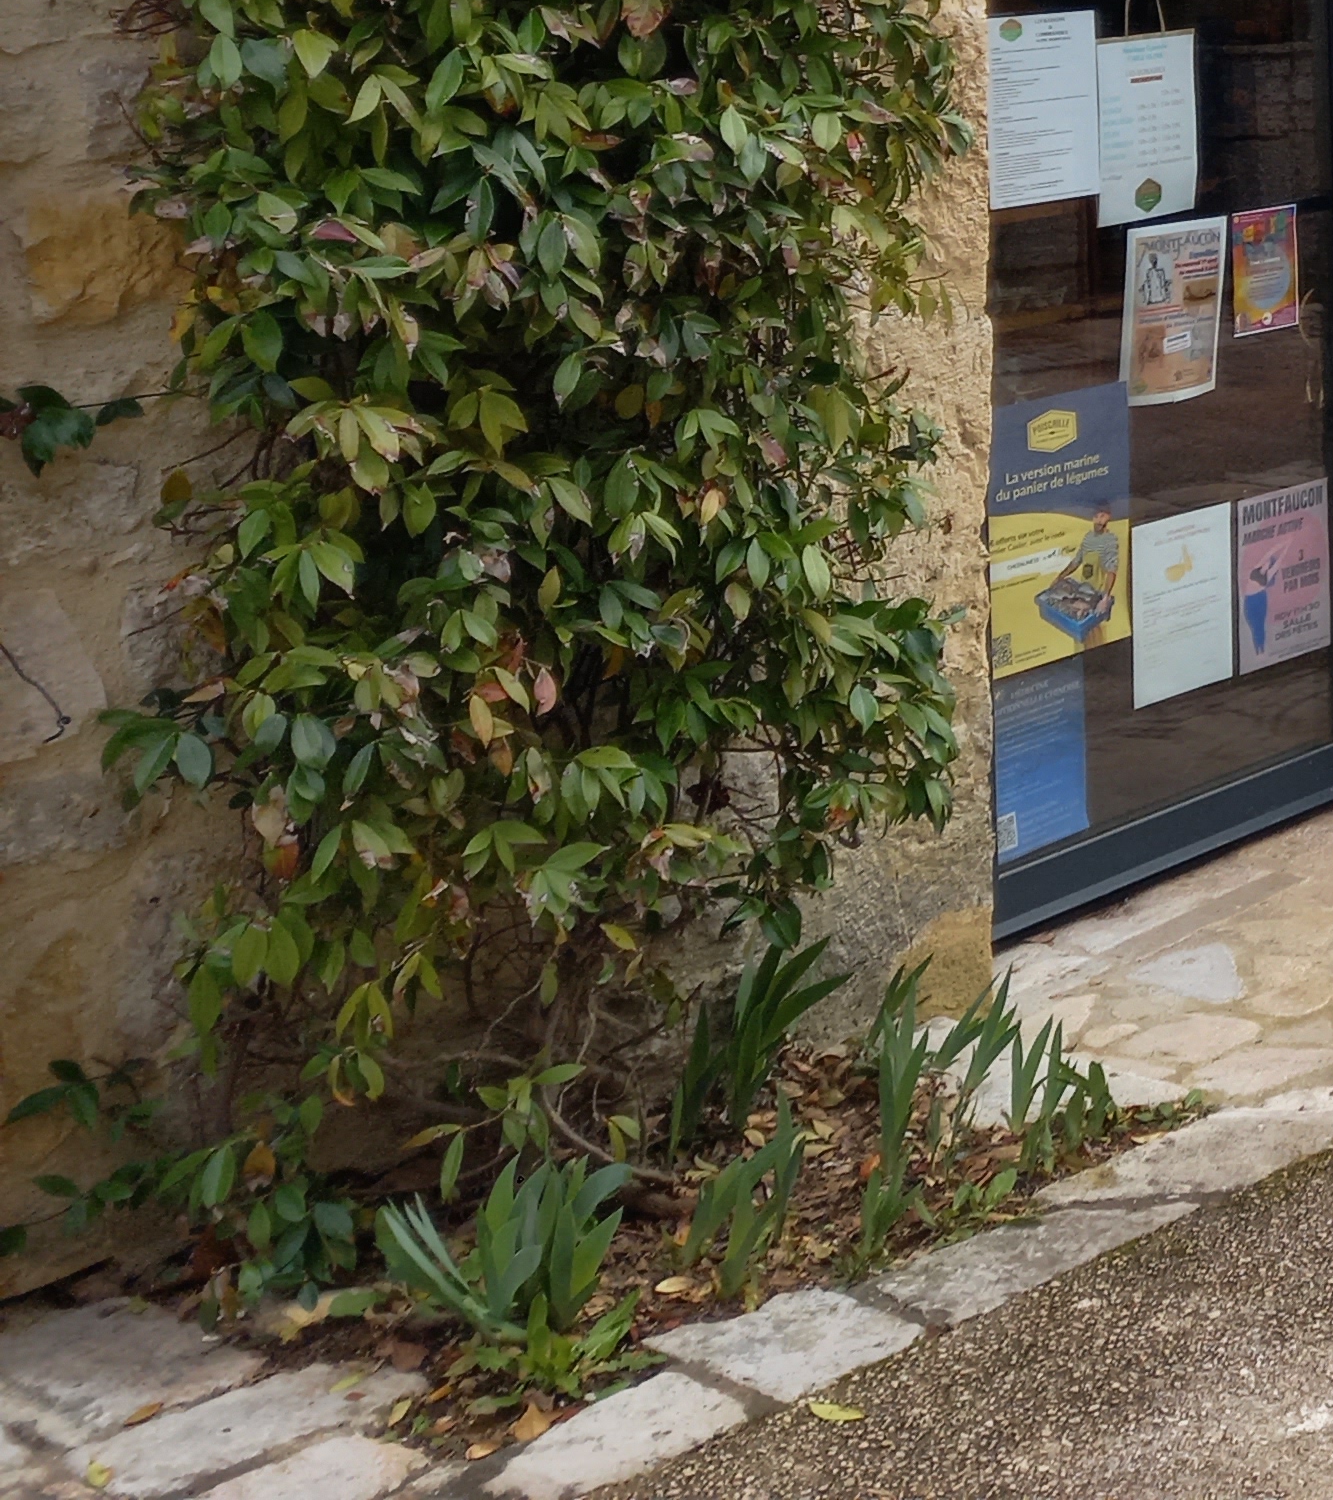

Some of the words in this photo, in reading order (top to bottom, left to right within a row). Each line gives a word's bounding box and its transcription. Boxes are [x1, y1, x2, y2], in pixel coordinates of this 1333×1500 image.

[995, 488, 1010, 502] du
[1013, 481, 1048, 501] panier
[1050, 476, 1063, 489] de
[1066, 466, 1109, 485] légumes
[1005, 473, 1019, 485] La
[1020, 464, 1061, 481] version
[1063, 454, 1100, 471] marine
[1242, 485, 1323, 526] MONTFAUCON
